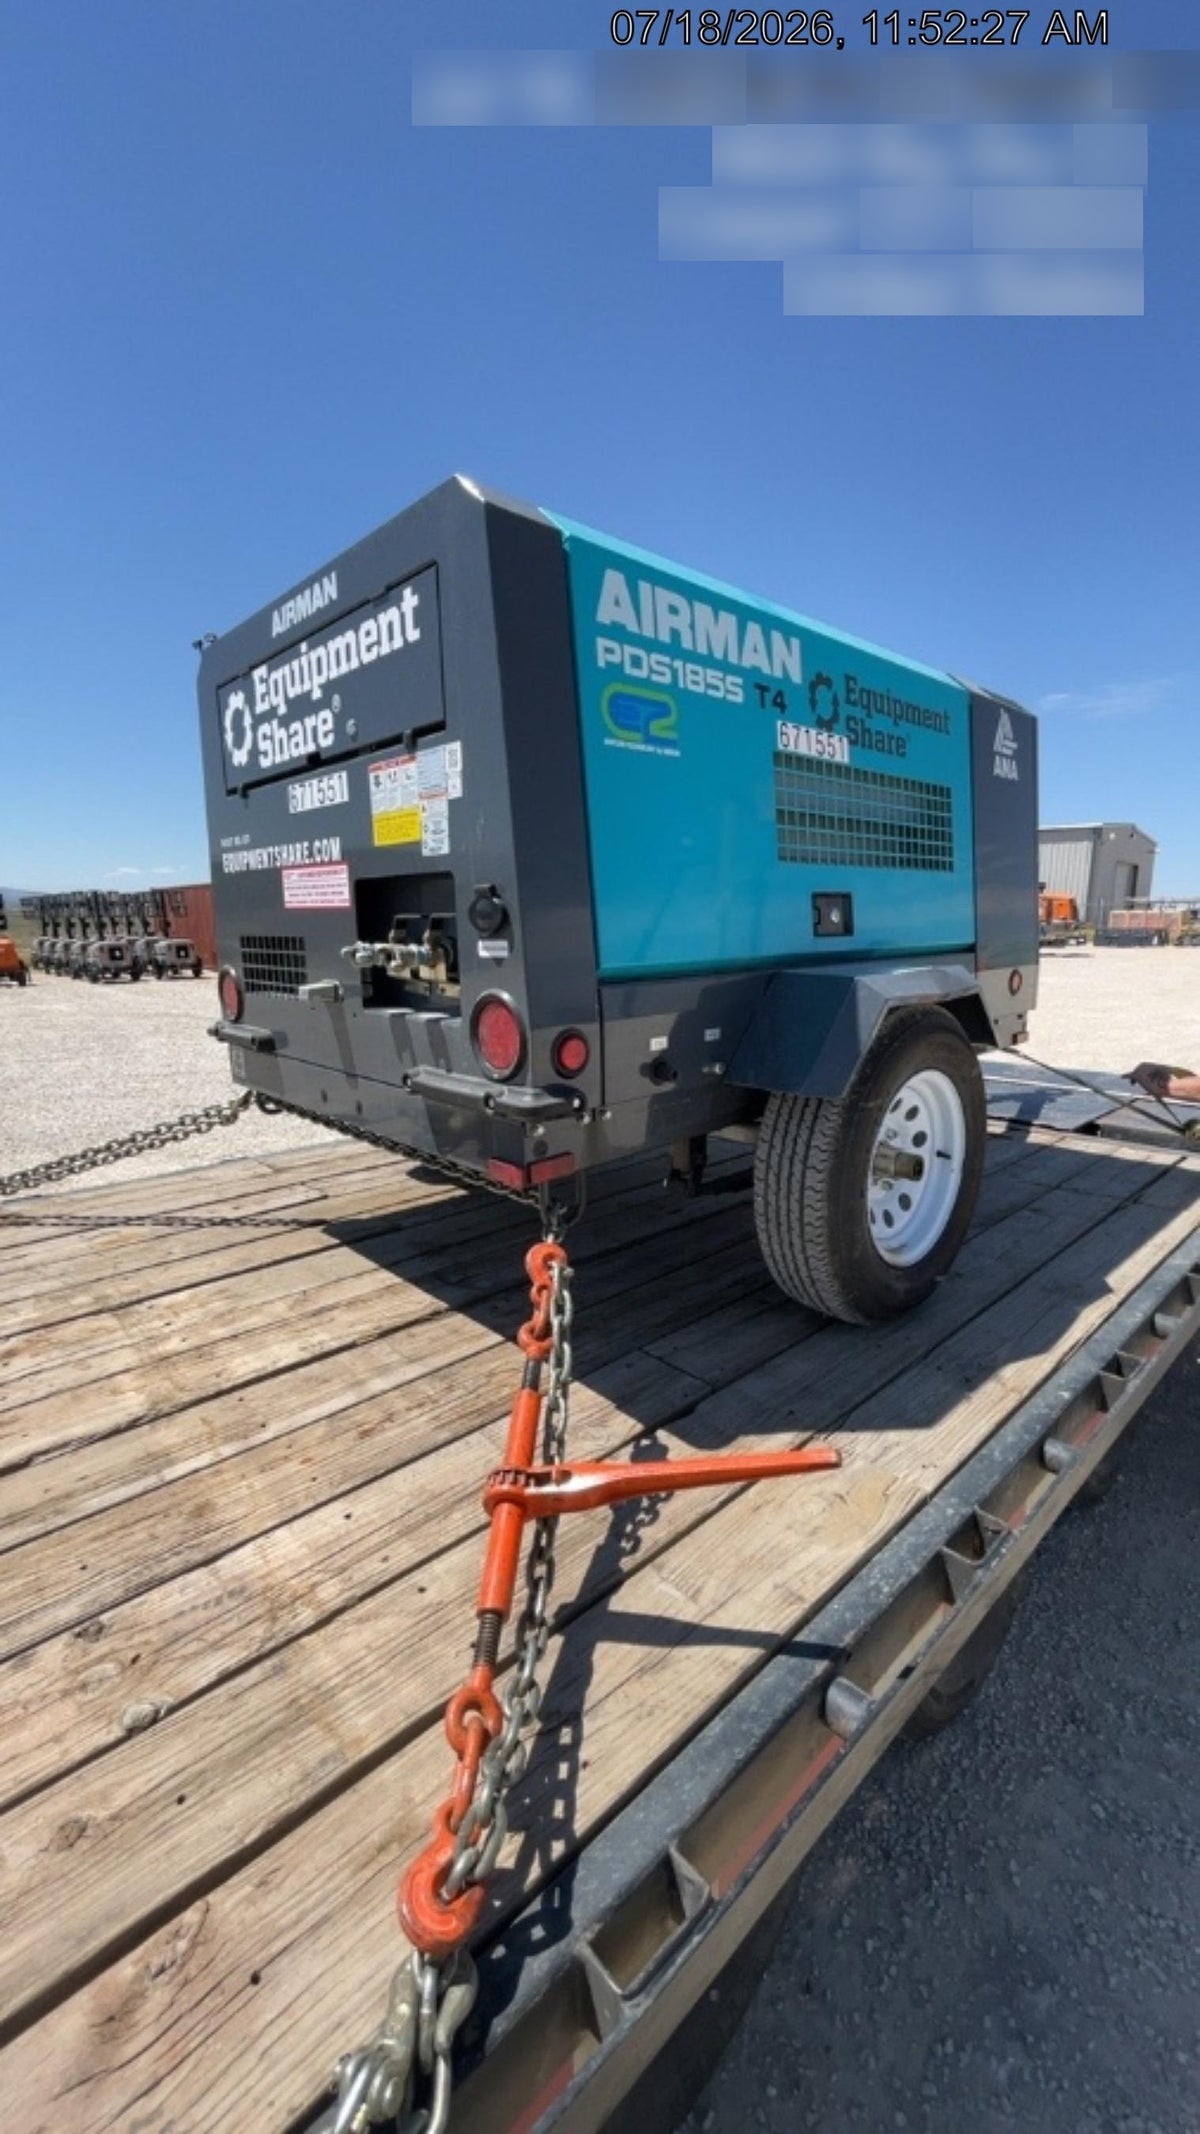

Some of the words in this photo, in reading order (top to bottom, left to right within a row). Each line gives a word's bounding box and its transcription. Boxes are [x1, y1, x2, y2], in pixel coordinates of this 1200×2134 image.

[271, 571, 338, 638] AIRMAN
[596, 568, 802, 684] AIRMAN
[252, 586, 421, 716] Equipment
[596, 637, 744, 703] PDS185S
[754, 682, 787, 714] T4
[844, 673, 950, 735] Equipment
[779, 722, 847, 760] 671551
[845, 715, 907, 758] Share
[290, 774, 346, 810] 671551
[222, 836, 341, 873] EQUIPMENTSHARE.COM
